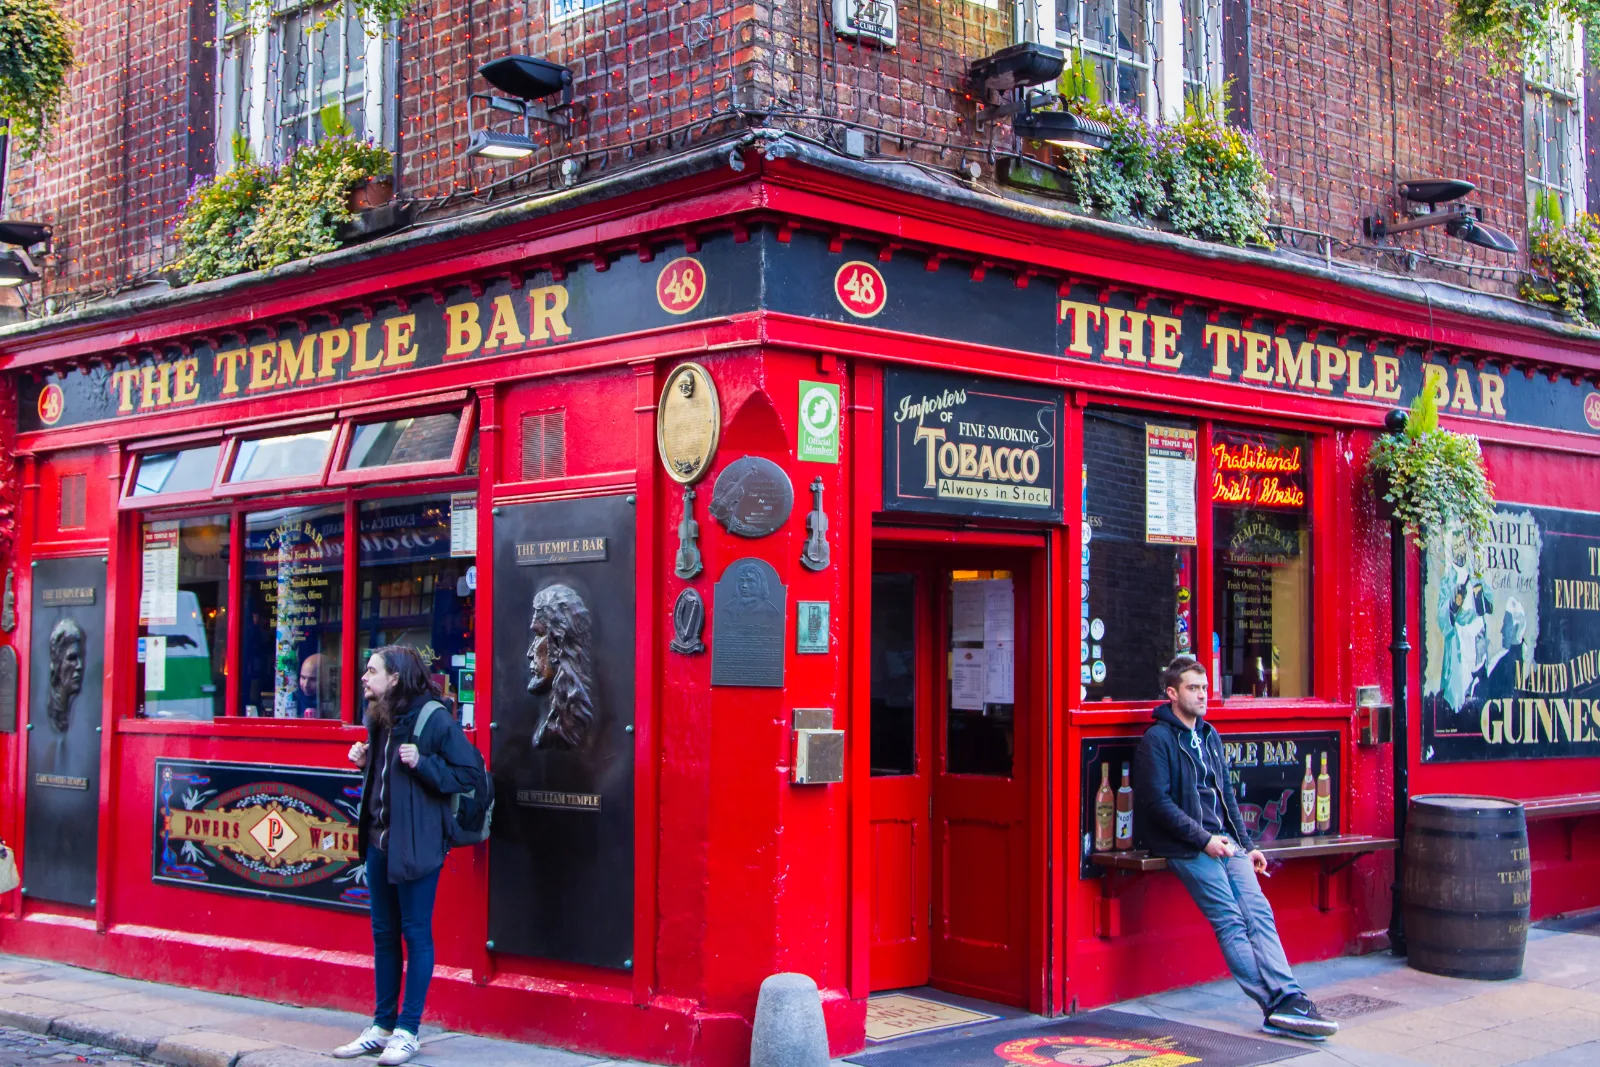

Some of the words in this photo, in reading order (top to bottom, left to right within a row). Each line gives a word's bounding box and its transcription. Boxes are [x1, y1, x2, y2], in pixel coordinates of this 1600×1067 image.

[664, 268, 698, 304] 48
[843, 268, 876, 304] 48
[112, 357, 200, 413] THE
[216, 313, 420, 396] TEMPLE
[444, 284, 572, 361] BAR
[1060, 300, 1184, 370] THE
[1204, 324, 1402, 402] TEMPLE
[1423, 362, 1507, 418] BAR
[42, 393, 59, 418] 48
[894, 388, 967, 426] Importers
[940, 411, 953, 423] OF
[807, 436, 831, 447] Official
[958, 421, 986, 439] FINE
[987, 424, 1039, 444] SMOKING
[805, 445, 833, 454] Member
[914, 425, 1040, 489] TOBACCO
[1212, 443, 1300, 472] Traditional
[940, 480, 989, 498] Always
[995, 486, 1007, 500] in
[1012, 486, 1049, 502] Stock
[1211, 472, 1251, 501] Irish
[1258, 477, 1304, 506] Music
[304, 522, 323, 547] BAR
[516, 543, 536, 556] THE
[538, 540, 580, 555] TEMPLE
[582, 538, 604, 552] BAR
[1230, 522, 1271, 550] TEMPLE
[1486, 546, 1522, 574] BAR
[1553, 578, 1600, 609] EMPER
[1513, 659, 1568, 694] MALTED
[1262, 740, 1299, 766] BAR
[566, 794, 600, 806] TEMPLE
[185, 815, 241, 840] POWERS
[266, 817, 283, 849] P
